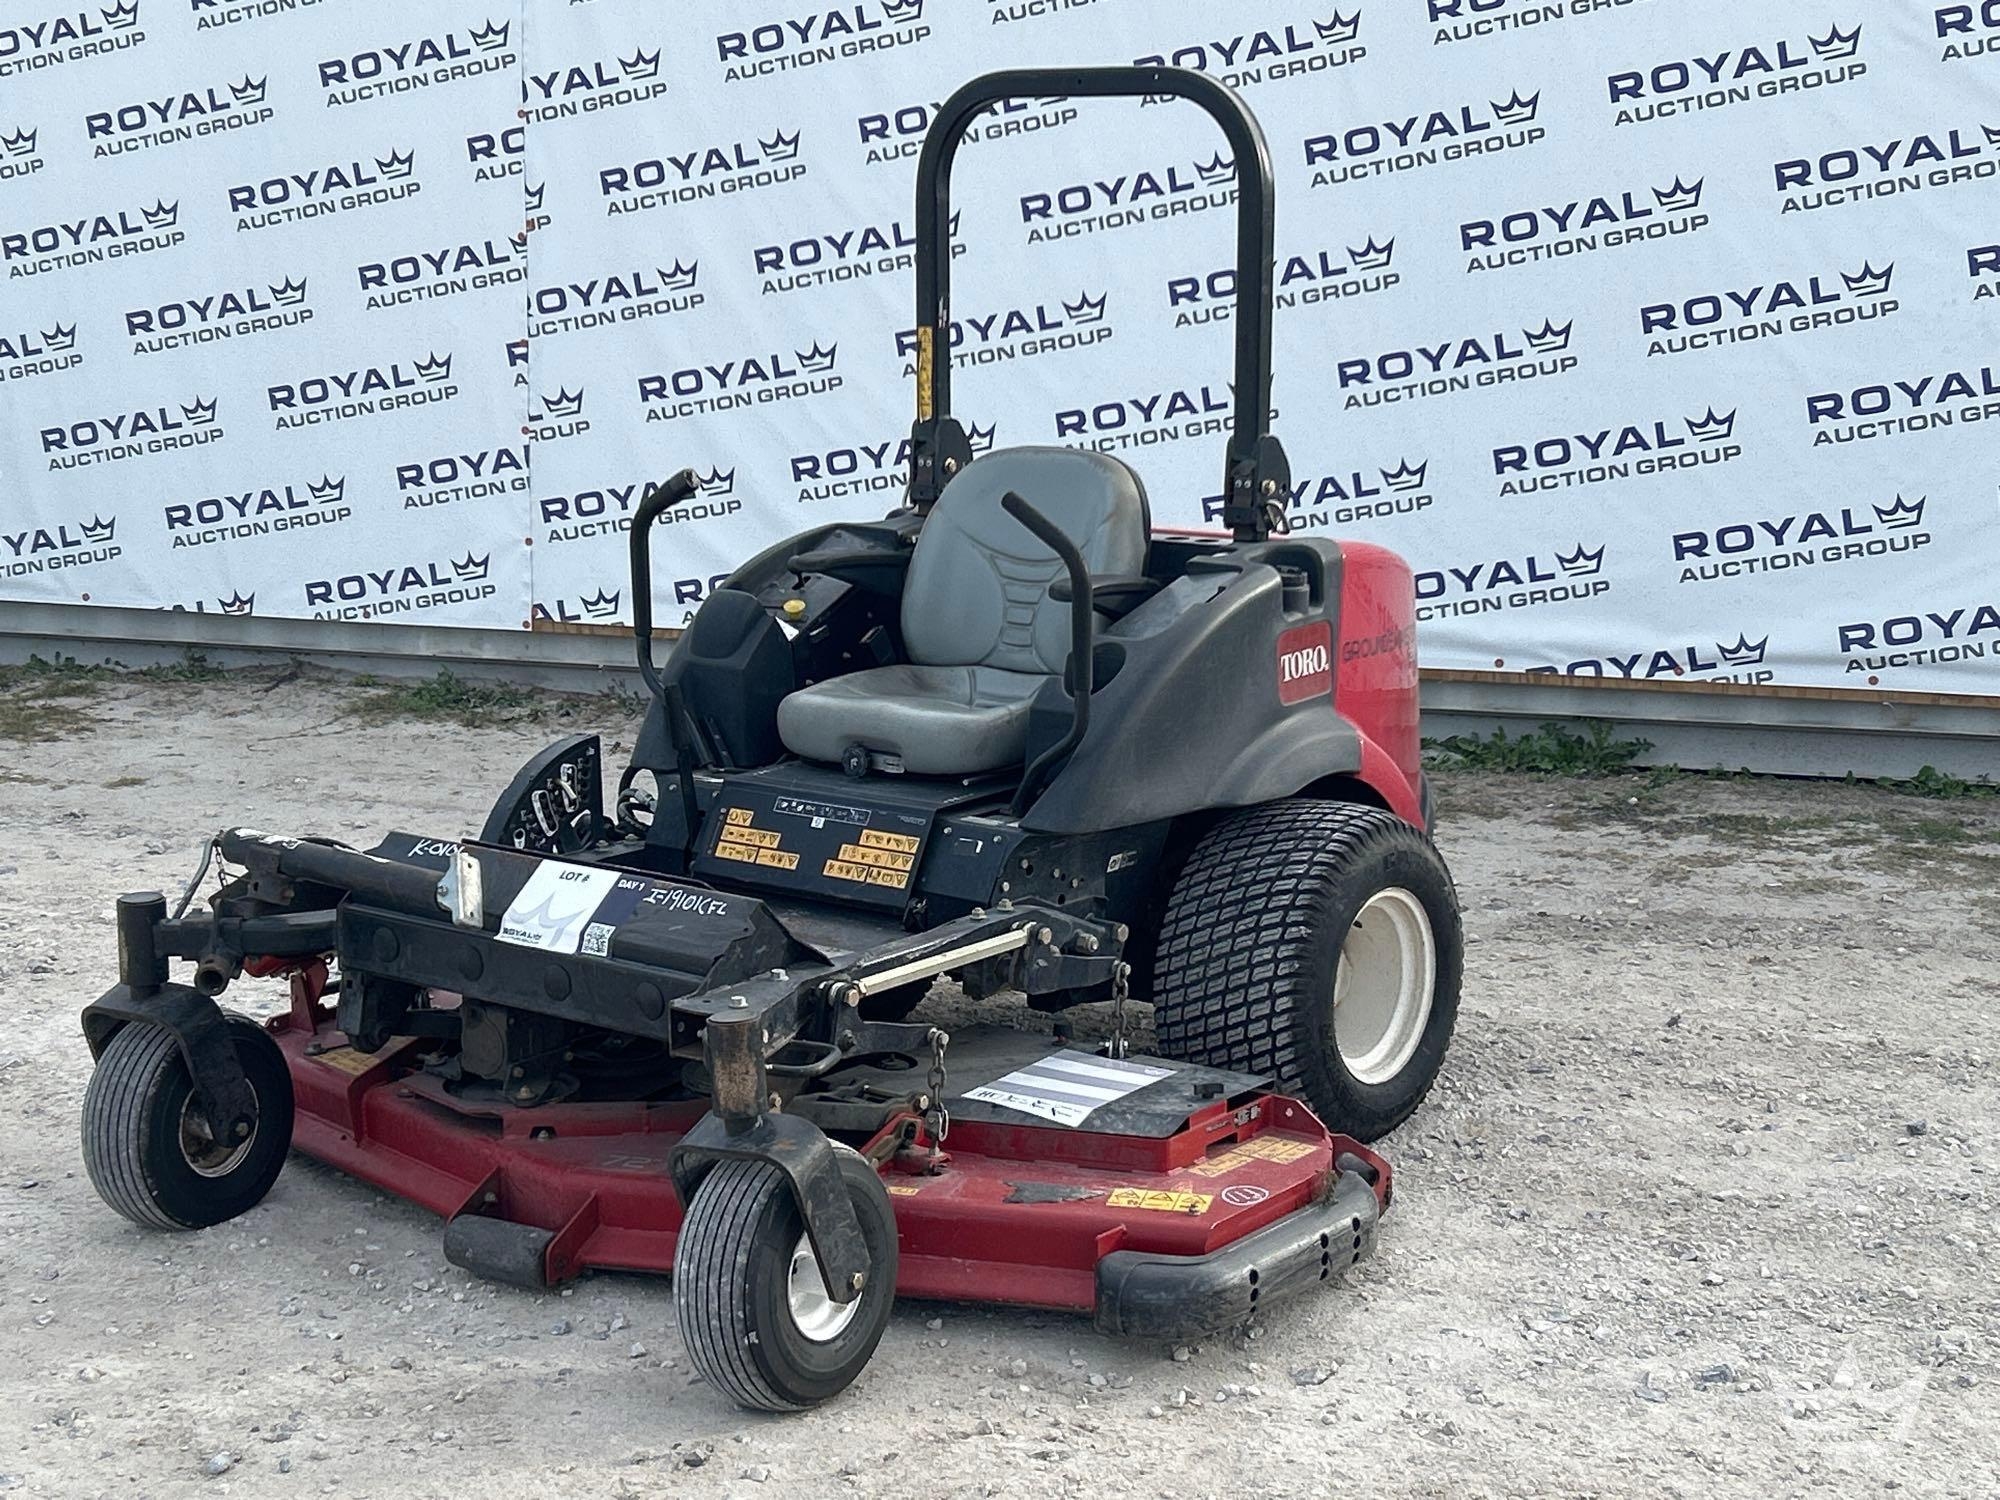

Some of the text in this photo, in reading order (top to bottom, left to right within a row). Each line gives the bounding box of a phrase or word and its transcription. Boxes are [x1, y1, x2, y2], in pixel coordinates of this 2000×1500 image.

[0, 13, 102, 56] OYAL
[197, 0, 296, 31] AUCTION
[717, 5, 882, 62] ROYAL
[1434, 3, 1564, 45] AUCTION
[0, 32, 146, 76] CTION GROUP
[318, 34, 471, 88] ROYAL
[725, 26, 931, 83] AUCTION GROUP
[1268, 47, 1367, 80] GROUP
[1608, 40, 1808, 104] ROYAL
[327, 53, 516, 108] AUCTION GROUP
[523, 62, 620, 103] YAL
[523, 83, 668, 124] TION GROUP
[1615, 63, 1866, 126] AUCTION GROUP
[86, 88, 231, 139] ROYAL
[94, 108, 273, 159] AUCTION GROUP
[986, 108, 1078, 140] GROUP
[1304, 106, 1491, 166] ROYAL
[0, 159, 44, 179] OUP
[600, 143, 760, 196] ROYAL
[1311, 128, 1545, 188] AUCTION GROUP
[1775, 130, 1982, 191] ROYAL
[228, 162, 377, 212] ROYAL
[237, 182, 421, 232] AUCTION GROUP
[608, 164, 806, 216] AUCTION GROUP
[1021, 167, 1195, 223] ROYAL
[1781, 160, 2000, 215] AUCTION GRO
[1, 212, 144, 260] ROYAL
[1028, 208, 1145, 245] AUCTION
[1460, 192, 1653, 251] ROYAL
[1467, 214, 1709, 273] AUCTION GROUP
[10, 231, 185, 279] AUCTION GROUP
[358, 241, 511, 291] ROYAL
[754, 222, 916, 275] ROYAL
[367, 267, 529, 311] AUCTION GRO
[762, 262, 872, 296] AUCTION
[1302, 273, 1400, 304] GROUP
[125, 289, 271, 336] ROYAL
[527, 294, 705, 338] UCTION GROUP
[1641, 277, 1841, 335] ROYAL
[1647, 300, 1899, 357] AUCTION GROUP
[134, 309, 313, 355] AUCTION GROUP
[1021, 328, 1113, 356] GROUP
[9, 354, 83, 379] GROUP
[638, 354, 796, 403] ROYAL
[1337, 333, 1523, 388] ROYAL
[1344, 356, 1577, 410] AUCTION GROUP
[268, 364, 415, 411] ROYAL
[276, 385, 458, 430] AUCTION GROUP
[646, 376, 843, 423] AUCTION GROUP
[40, 408, 183, 453] ROYAL
[1056, 386, 1228, 437] ROYAL
[1813, 410, 1954, 447] AUCTION
[49, 428, 224, 471] AUCTION GROUP
[1493, 421, 1685, 475] ROYAL
[1500, 445, 1741, 497] AUCTION GROUP
[165, 486, 309, 530] ROYAL
[405, 481, 507, 510] AUCTION
[799, 473, 908, 503] AUCTION
[1336, 495, 1433, 522] GROUP
[173, 507, 351, 549] AUCTION GROUP
[657, 500, 742, 525] GROUP
[1672, 508, 1873, 561] ROYAL
[2, 526, 82, 557] YAL
[48, 547, 122, 570] GROUP
[1679, 533, 1931, 583] AUCTION GROUP
[305, 563, 452, 606] ROYAL
[416, 585, 496, 608] GROUP
[1414, 557, 1556, 600] OYAL
[1416, 581, 1610, 621] CTION GROUP
[1839, 606, 2000, 653] ROYA
[1846, 643, 1985, 674] AUCTION
[559, 870, 582, 881] LOT
[618, 879, 646, 892] DAY 1
